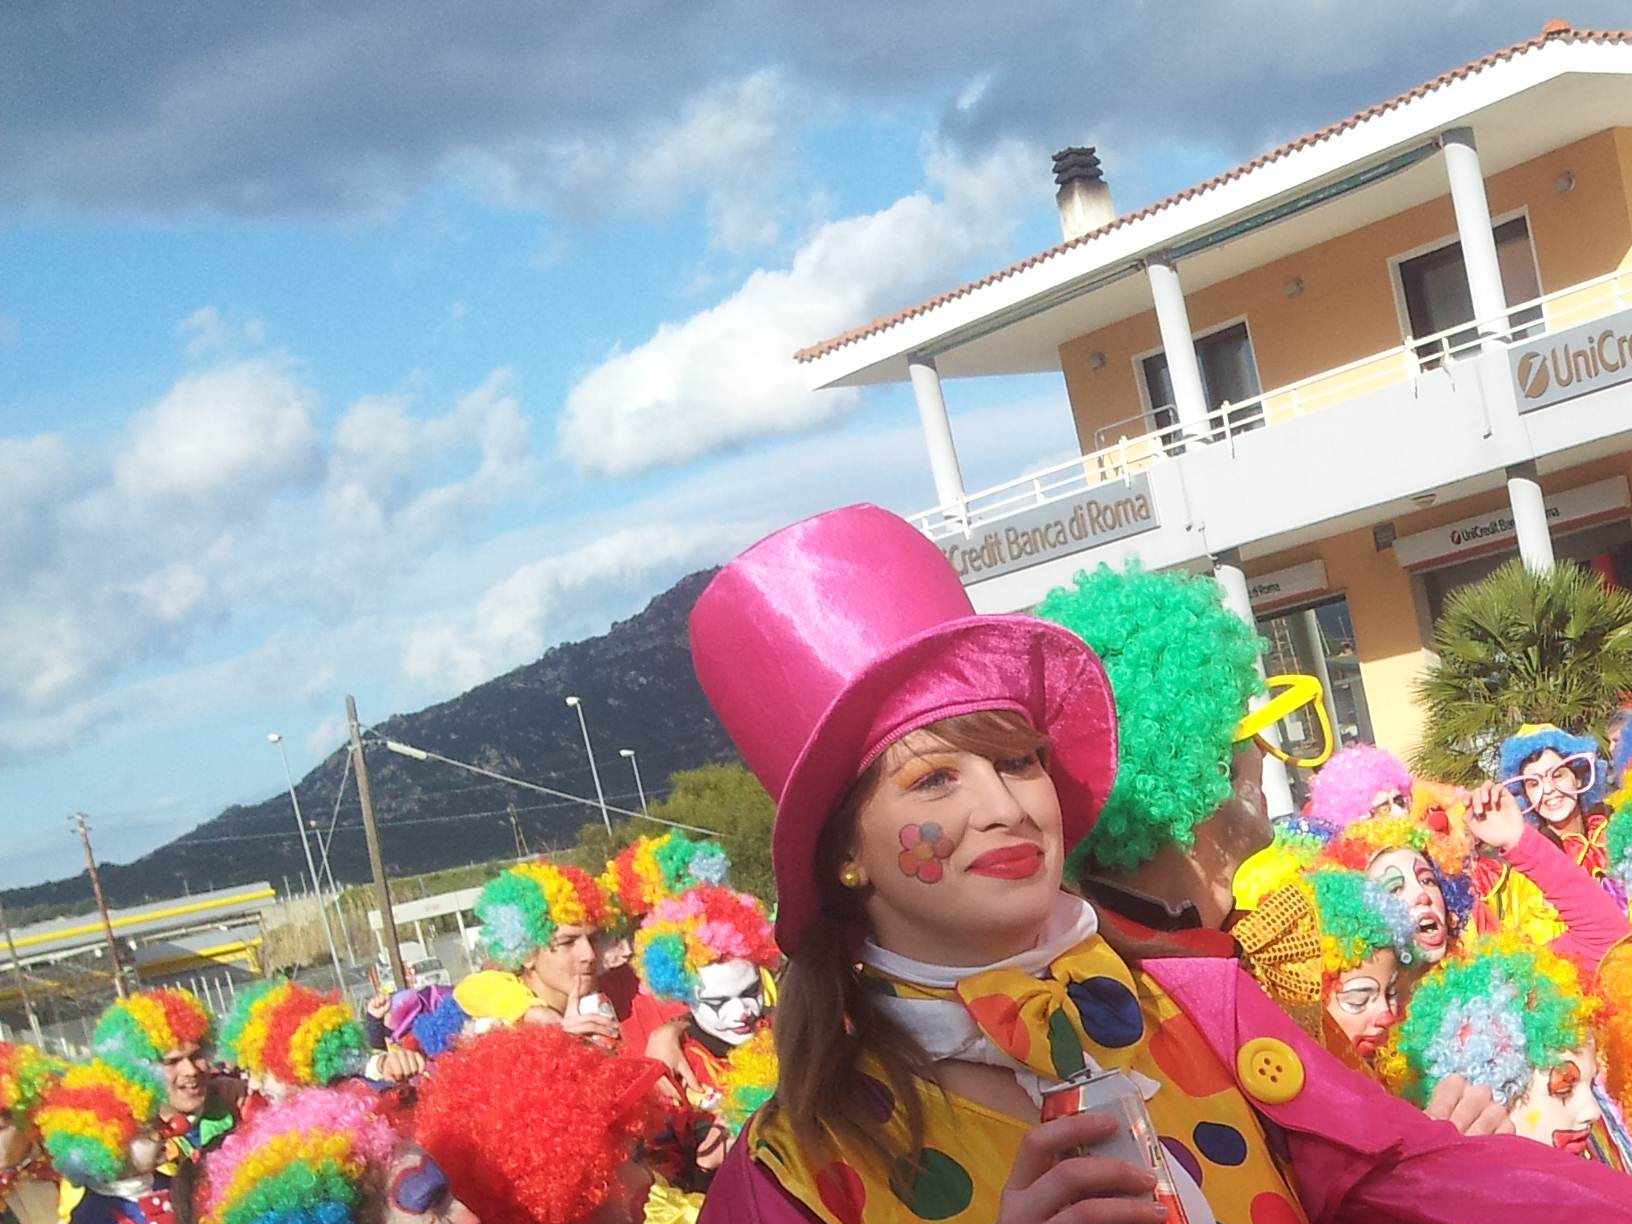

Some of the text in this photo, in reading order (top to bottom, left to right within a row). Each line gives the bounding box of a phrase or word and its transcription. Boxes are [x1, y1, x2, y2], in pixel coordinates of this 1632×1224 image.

[944, 494, 1152, 577] Credit Banca di Roma
